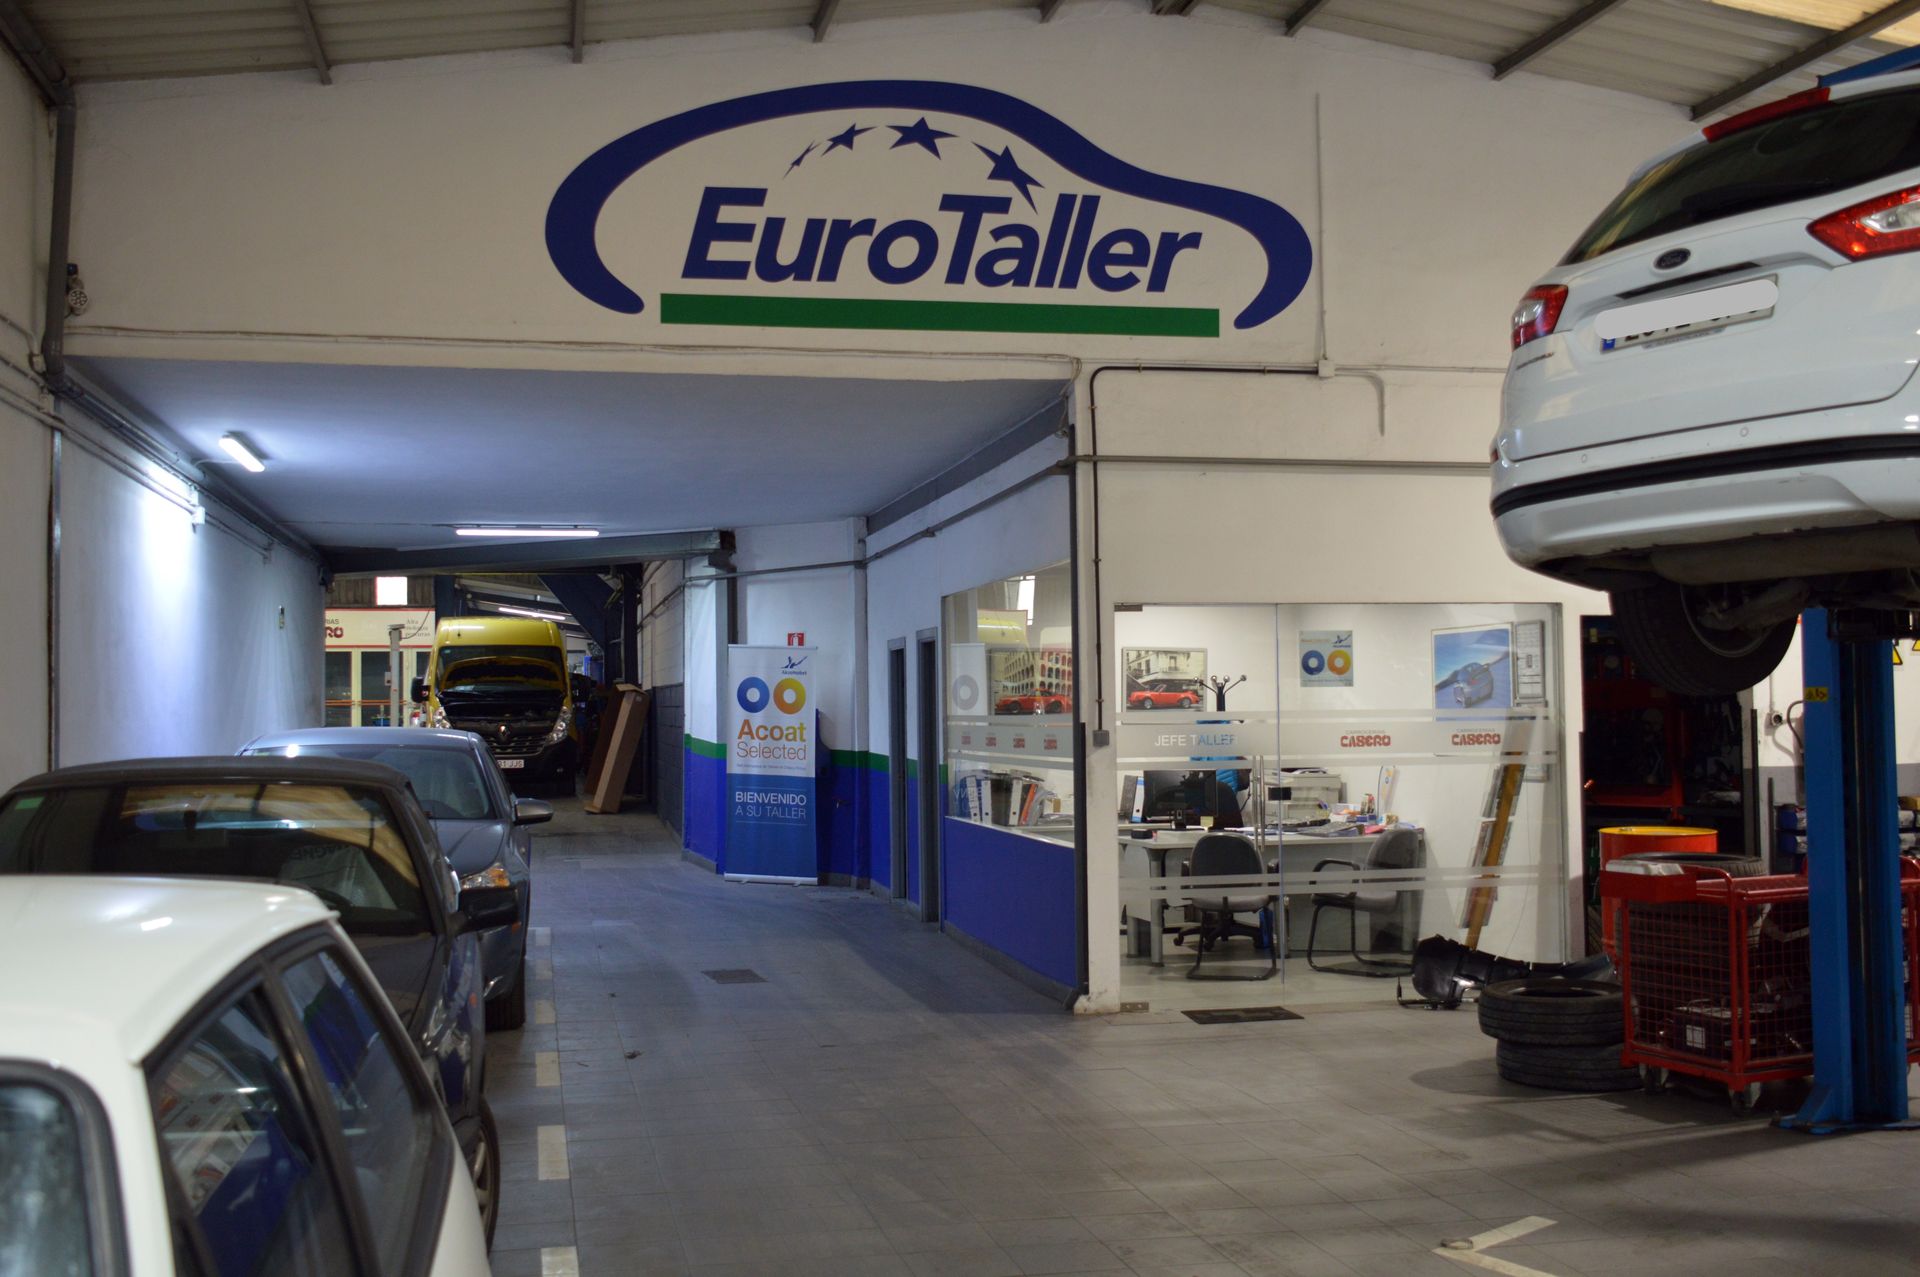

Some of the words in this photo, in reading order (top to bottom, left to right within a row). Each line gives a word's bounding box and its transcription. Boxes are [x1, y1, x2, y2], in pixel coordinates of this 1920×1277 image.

[681, 186, 1202, 292] EuroTaller
[737, 719, 807, 742] Acoat
[1154, 734, 1187, 746] JEFE
[1189, 734, 1239, 746] TALLER
[737, 741, 807, 760] Selected
[735, 792, 807, 806] BIENVENIDO
[735, 805, 744, 816] A
[746, 805, 762, 817] SU
[766, 806, 807, 819] TALLER
